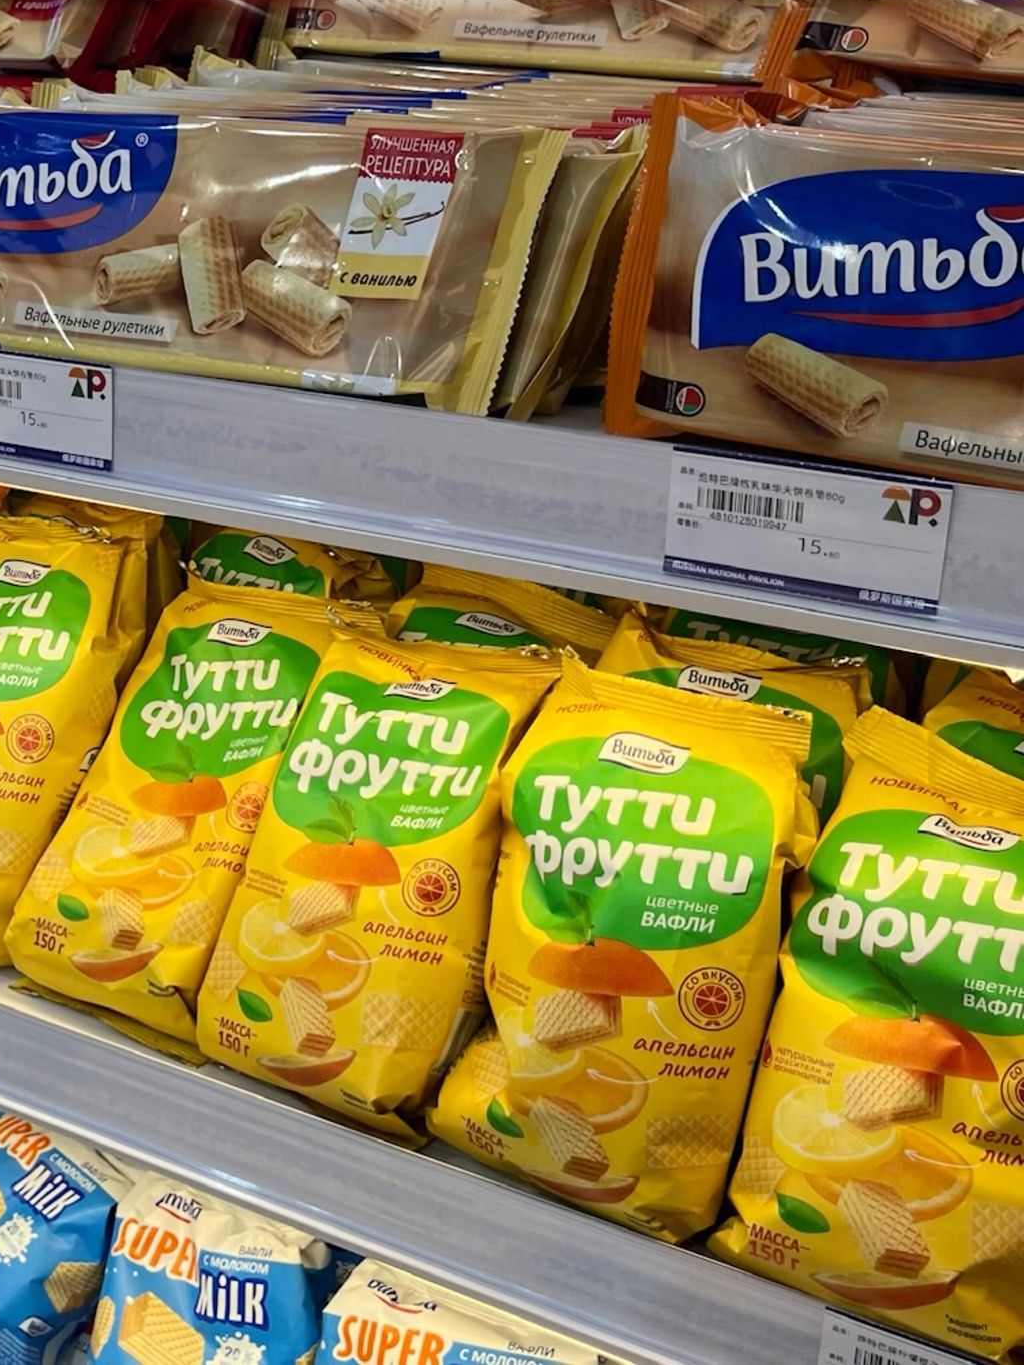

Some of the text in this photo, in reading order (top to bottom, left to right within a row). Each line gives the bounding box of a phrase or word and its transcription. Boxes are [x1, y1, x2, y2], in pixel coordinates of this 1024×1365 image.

[463, 21, 597, 43] Вафельные рулетики
[370, 134, 457, 156] УЛУЧШЕННАЯ
[364, 153, 452, 178] РЕЦЕПТУРА
[740, 205, 1024, 303] Витьб
[351, 269, 418, 289] ванилью
[102, 314, 166, 339] рулетики
[672, 559, 786, 588] RUSSIAN NATIONAL PAVILION
[216, 623, 262, 644] Витьба
[171, 652, 281, 701] Тутти
[687, 669, 751, 696] Витьба
[24, 715, 53, 742] ВКУСОМ
[139, 697, 298, 742] Фрутти
[319, 691, 471, 755] Тутти
[227, 734, 270, 749] цветные
[611, 737, 677, 768] Витьба
[222, 746, 263, 764] ВАФЛИ
[288, 738, 482, 800] Фрутти
[400, 803, 449, 816] цветные
[533, 774, 716, 837] Тутти
[390, 814, 443, 830] ВАФЛИ
[933, 816, 1005, 848] Витьба
[194, 840, 249, 859] апельси
[202, 857, 244, 874] лимо
[423, 860, 458, 893] ВКУСОМ
[525, 830, 755, 897] Фрутти
[645, 895, 720, 916] цветные
[35, 917, 69, 938] МАССА
[363, 921, 448, 947] апельсин
[640, 912, 716, 935] ВАФЛИ
[806, 894, 1024, 974] Фрутт
[33, 930, 59, 951] 150
[379, 944, 443, 966] лимон
[701, 970, 743, 1003] ВКУСОМ
[219, 1016, 253, 1040] МАССА
[217, 1030, 241, 1054] 150
[633, 1036, 736, 1061] апельсин
[658, 1060, 731, 1081] лимон
[464, 1116, 505, 1151] МАССА
[466, 1131, 495, 1157] 150
[55, 1156, 98, 1195] МОЛОКОМ
[12, 1164, 82, 1222] MiLK
[111, 1217, 201, 1284] SUPER
[749, 1223, 799, 1252] МАССА
[238, 1245, 273, 1259] ВАФЛИ
[748, 1239, 784, 1266] 150
[210, 1256, 270, 1275] МОЛОКОМ
[194, 1270, 269, 1328] MiLK
[337, 1315, 446, 1365] SUPER
